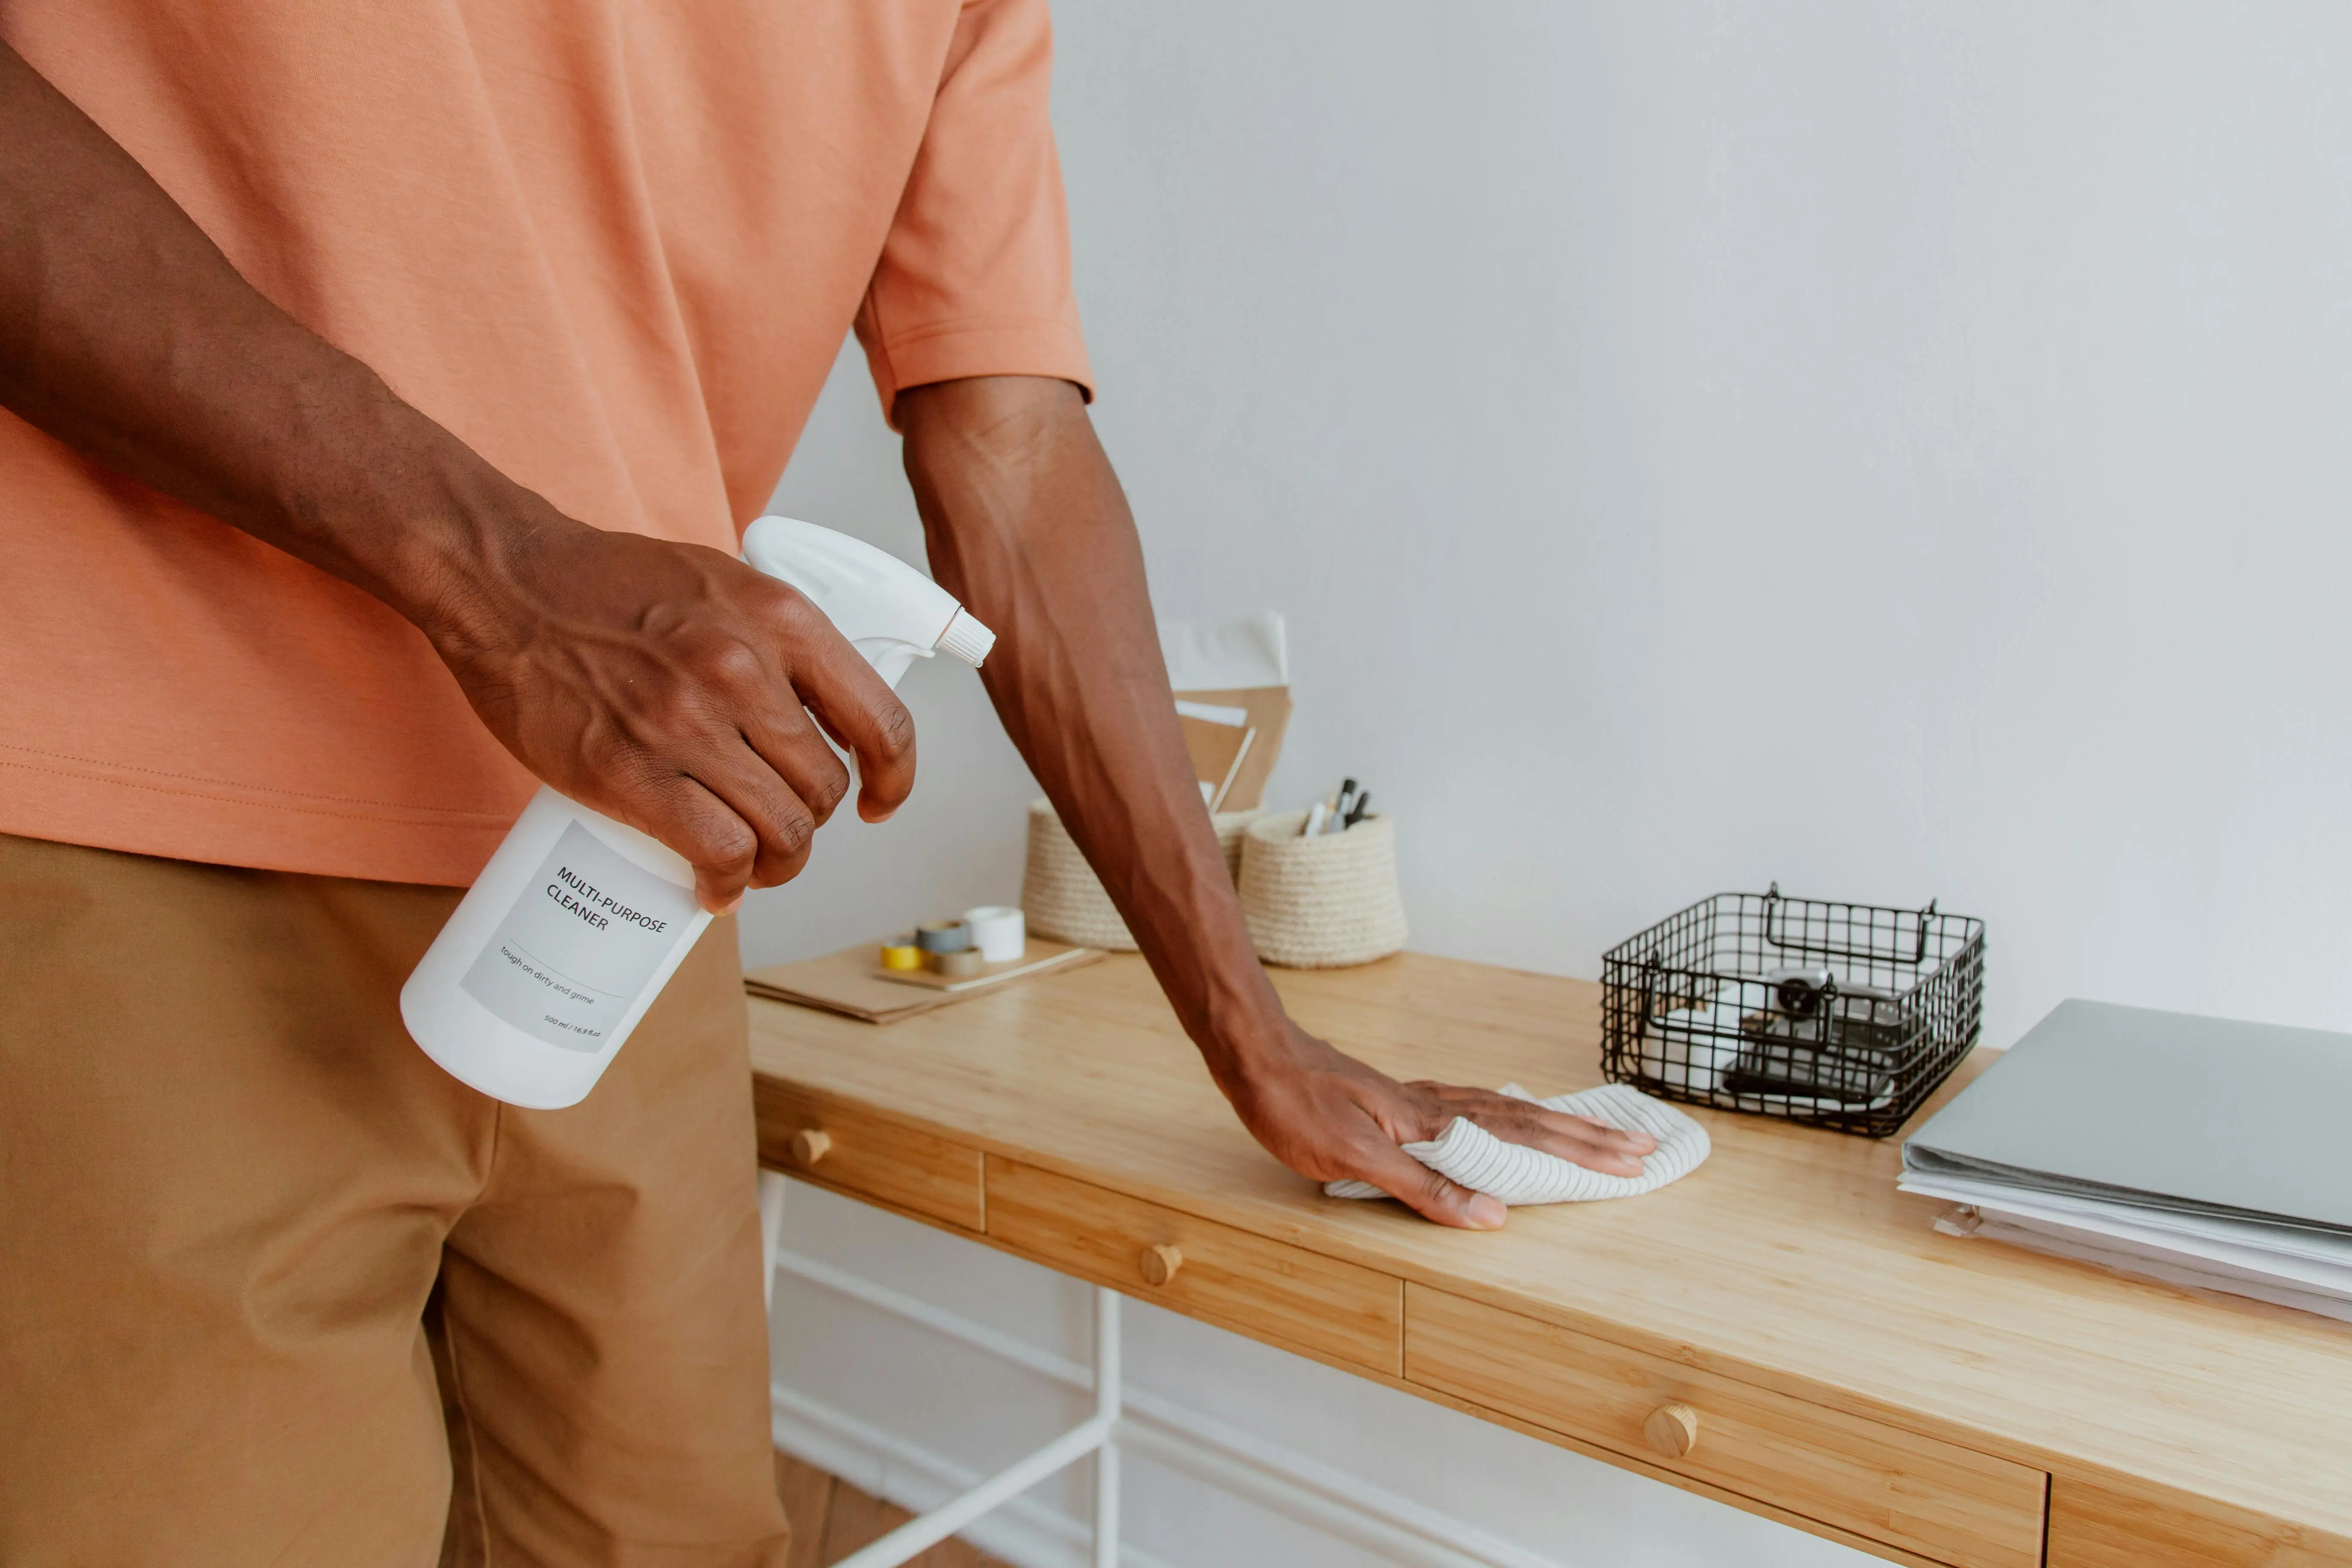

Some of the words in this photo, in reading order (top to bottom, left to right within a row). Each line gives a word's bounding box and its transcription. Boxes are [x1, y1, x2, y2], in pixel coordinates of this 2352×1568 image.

[547, 884, 609, 931] CLEANER
[557, 866, 667, 933] MULTI-PURPOSE
[501, 946, 522, 967] tough
[522, 965, 533, 974] on
[534, 972, 554, 986] dirty
[554, 983, 571, 995] and
[570, 992, 594, 1004] grime
[543, 1015, 558, 1025] 500
